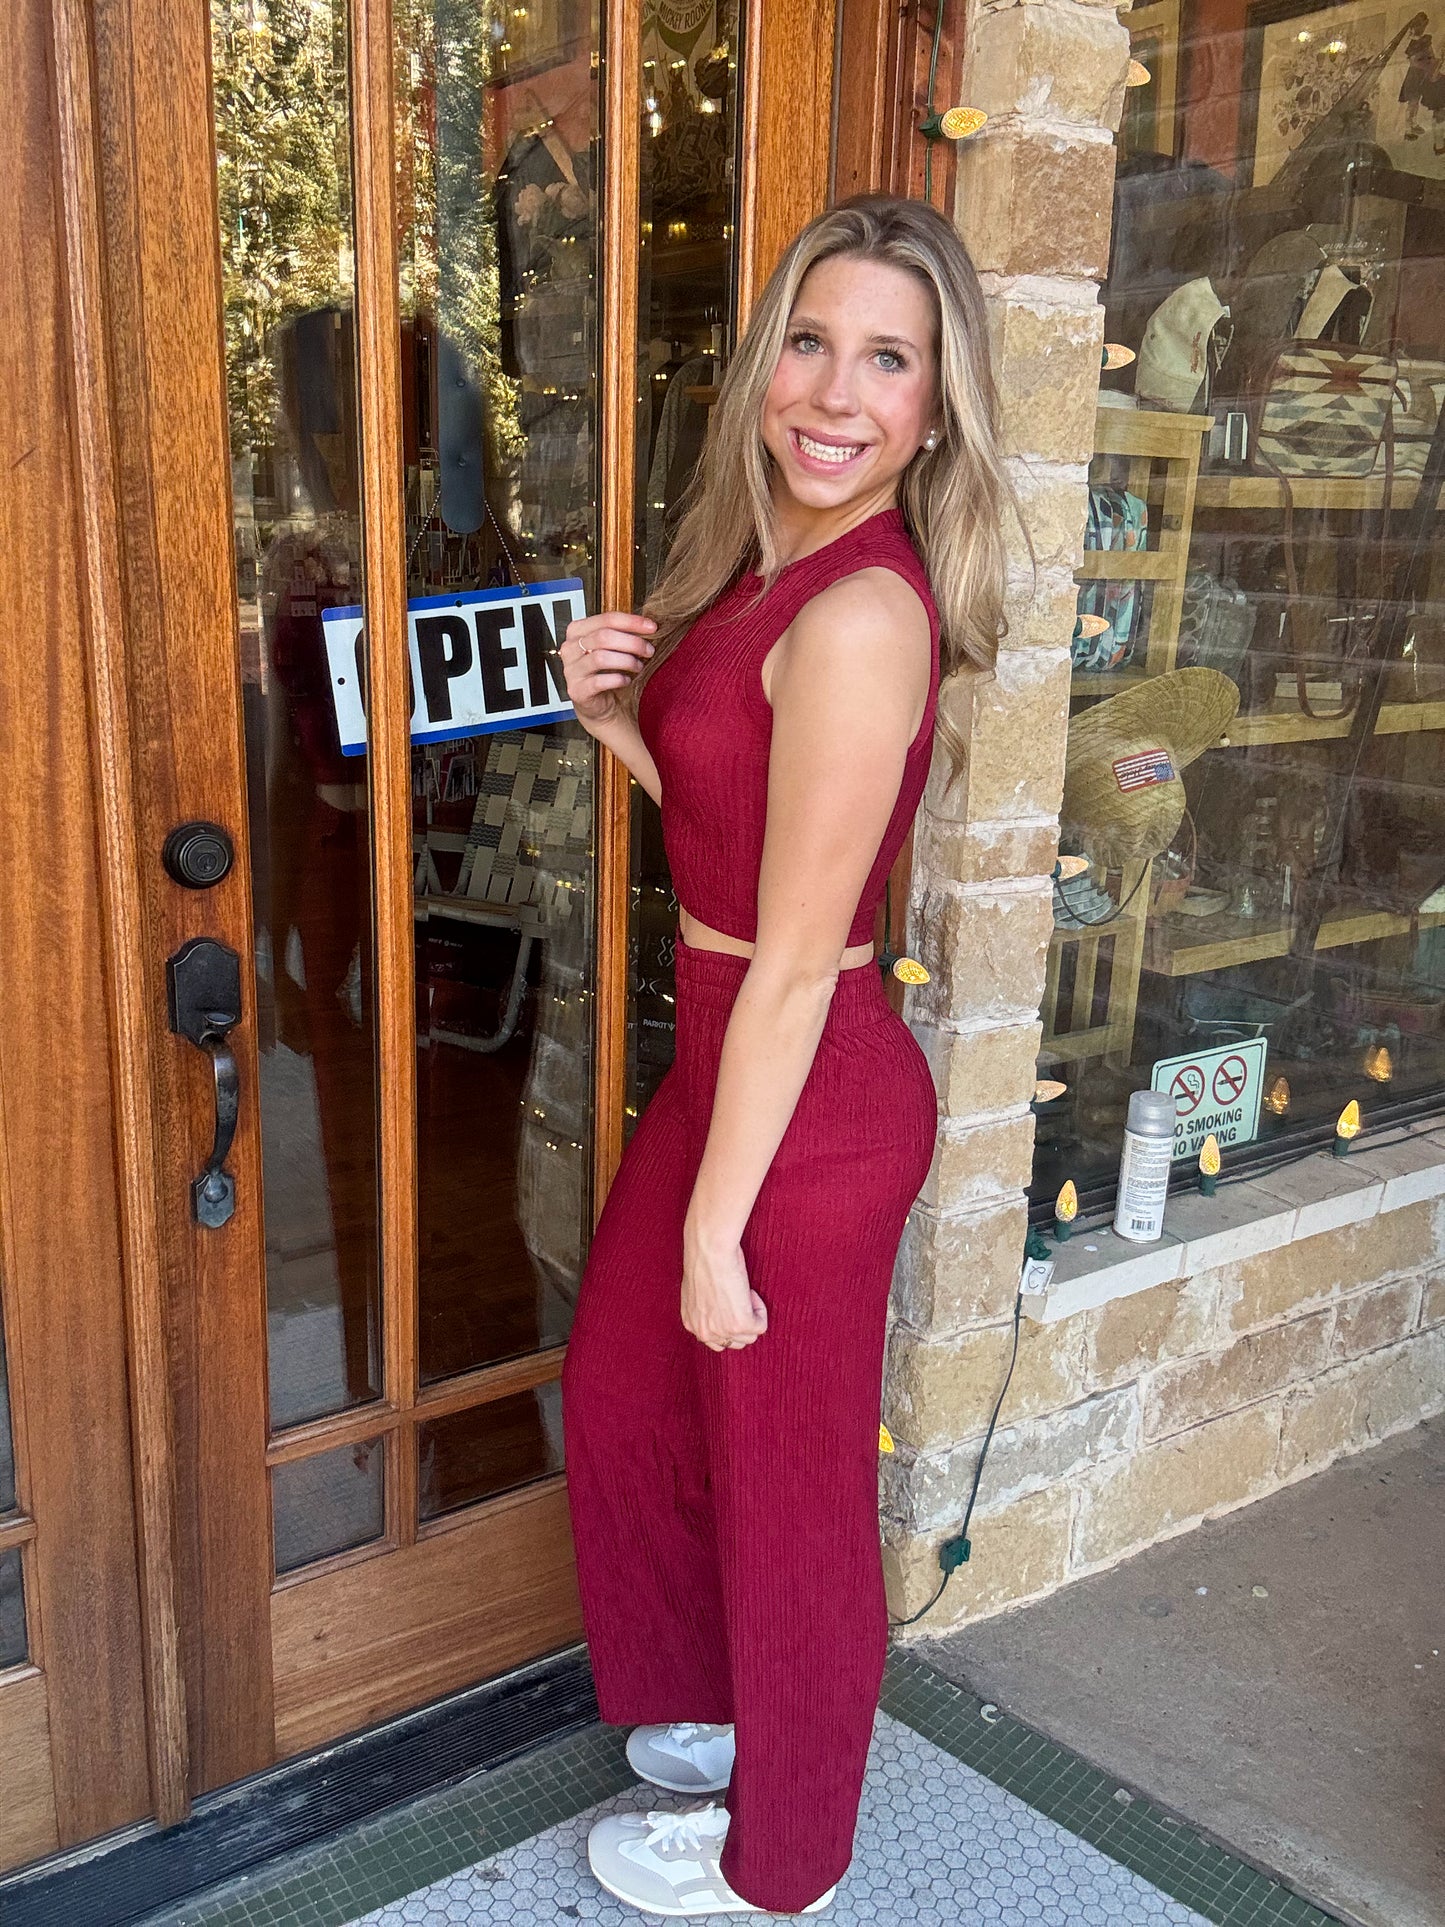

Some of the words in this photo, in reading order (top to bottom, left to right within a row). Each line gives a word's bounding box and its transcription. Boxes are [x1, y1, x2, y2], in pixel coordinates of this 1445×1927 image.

[660, 0, 682, 30] MICKEY
[643, 1018, 667, 1029] PARKIT
[1174, 1123, 1184, 1138] O
[1186, 1107, 1243, 1135] SMOKING
[1191, 1127, 1237, 1152] VAING
